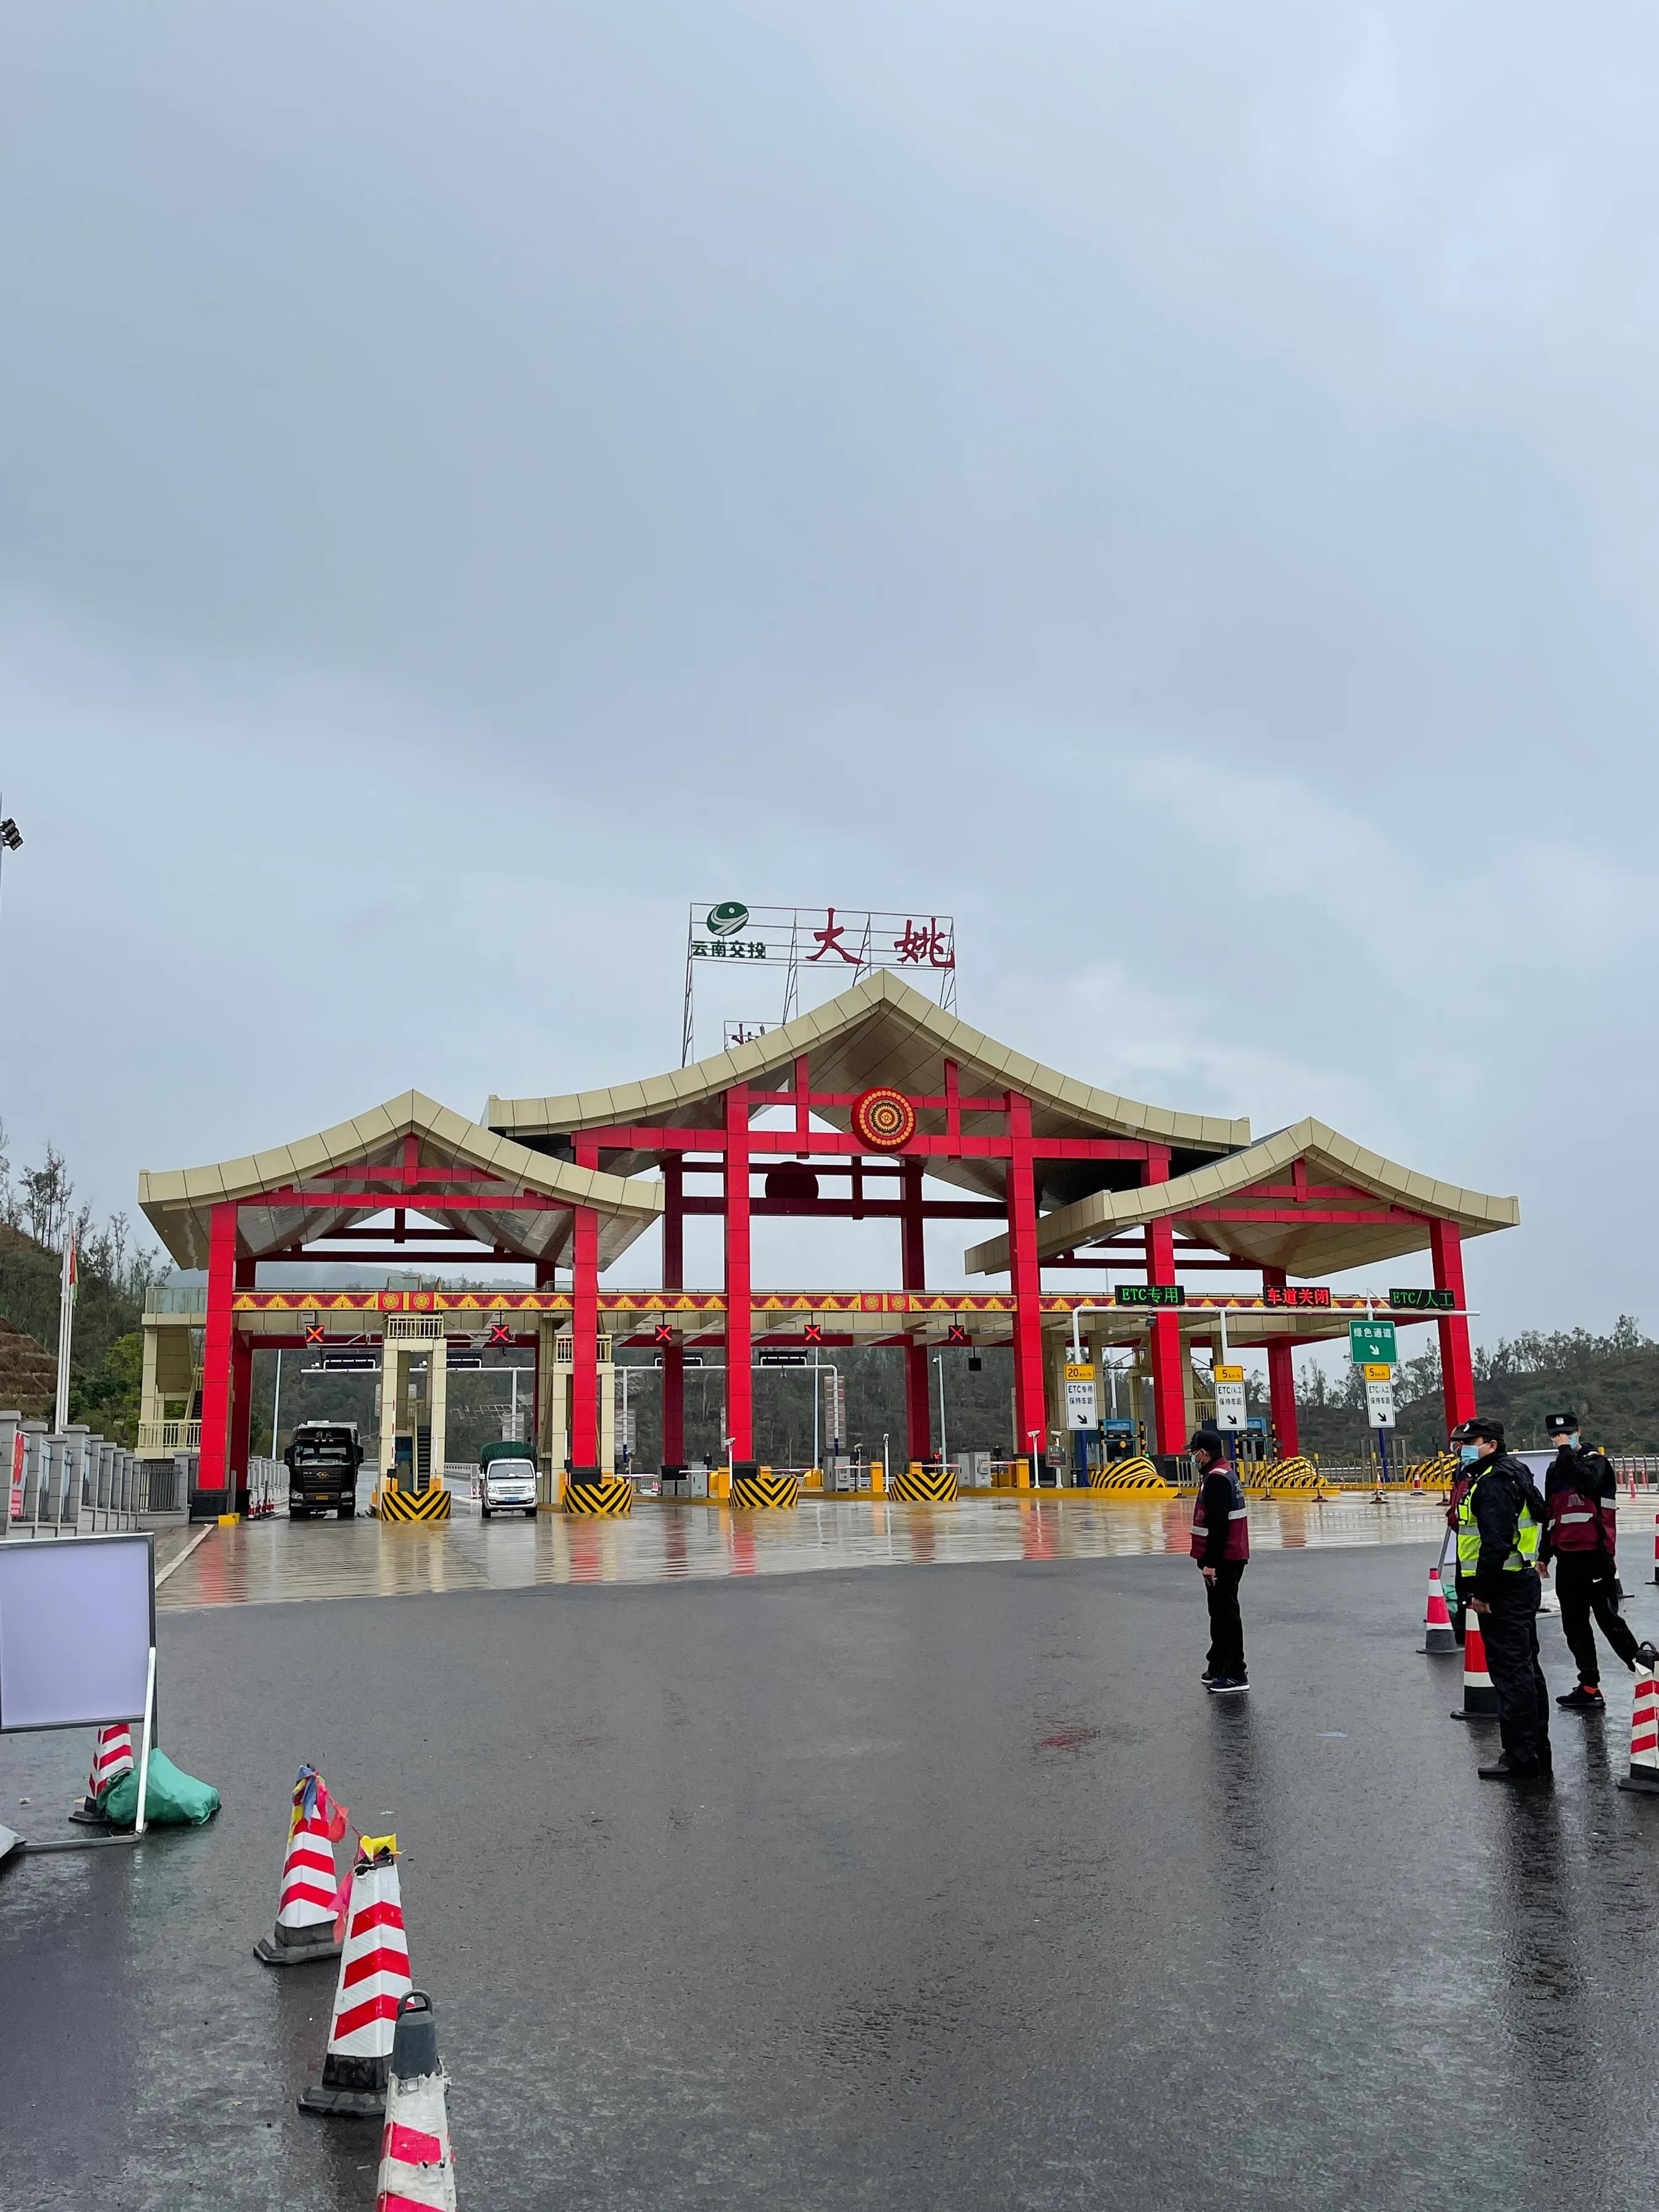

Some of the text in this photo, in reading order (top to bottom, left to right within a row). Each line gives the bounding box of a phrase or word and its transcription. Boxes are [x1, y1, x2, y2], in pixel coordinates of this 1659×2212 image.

[805, 908, 955, 968] 大姚
[691, 939, 766, 959] 云南交投
[1122, 1287, 1179, 1304] ETC专用
[1267, 1288, 1330, 1306] 车道关闭
[1393, 1291, 1454, 1307] ETC/人工
[1354, 1327, 1392, 1338] 绿色通道
